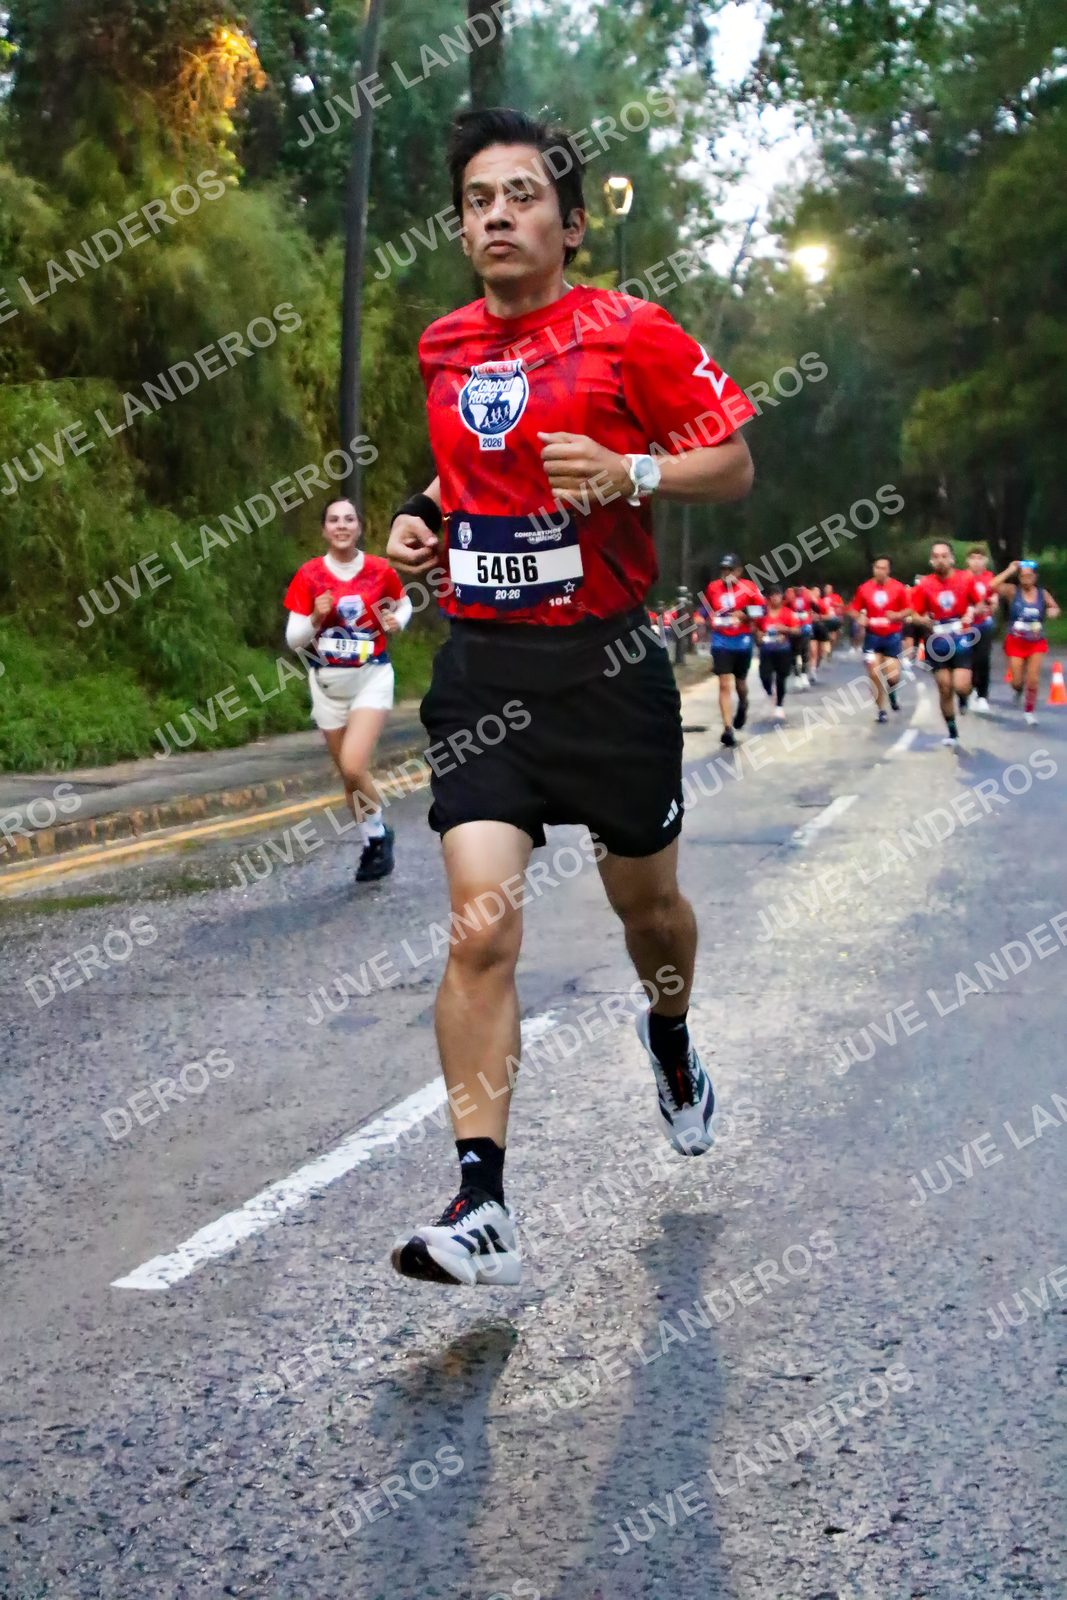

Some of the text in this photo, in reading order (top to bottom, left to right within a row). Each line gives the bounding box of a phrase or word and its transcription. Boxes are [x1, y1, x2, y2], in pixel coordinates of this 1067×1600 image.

[478, 379, 514, 392] Global
[468, 391, 498, 405] Race
[482, 438, 502, 448] 2026
[477, 554, 539, 584] 5466
[495, 588, 520, 600] 20-26
[549, 595, 572, 607] 10K
